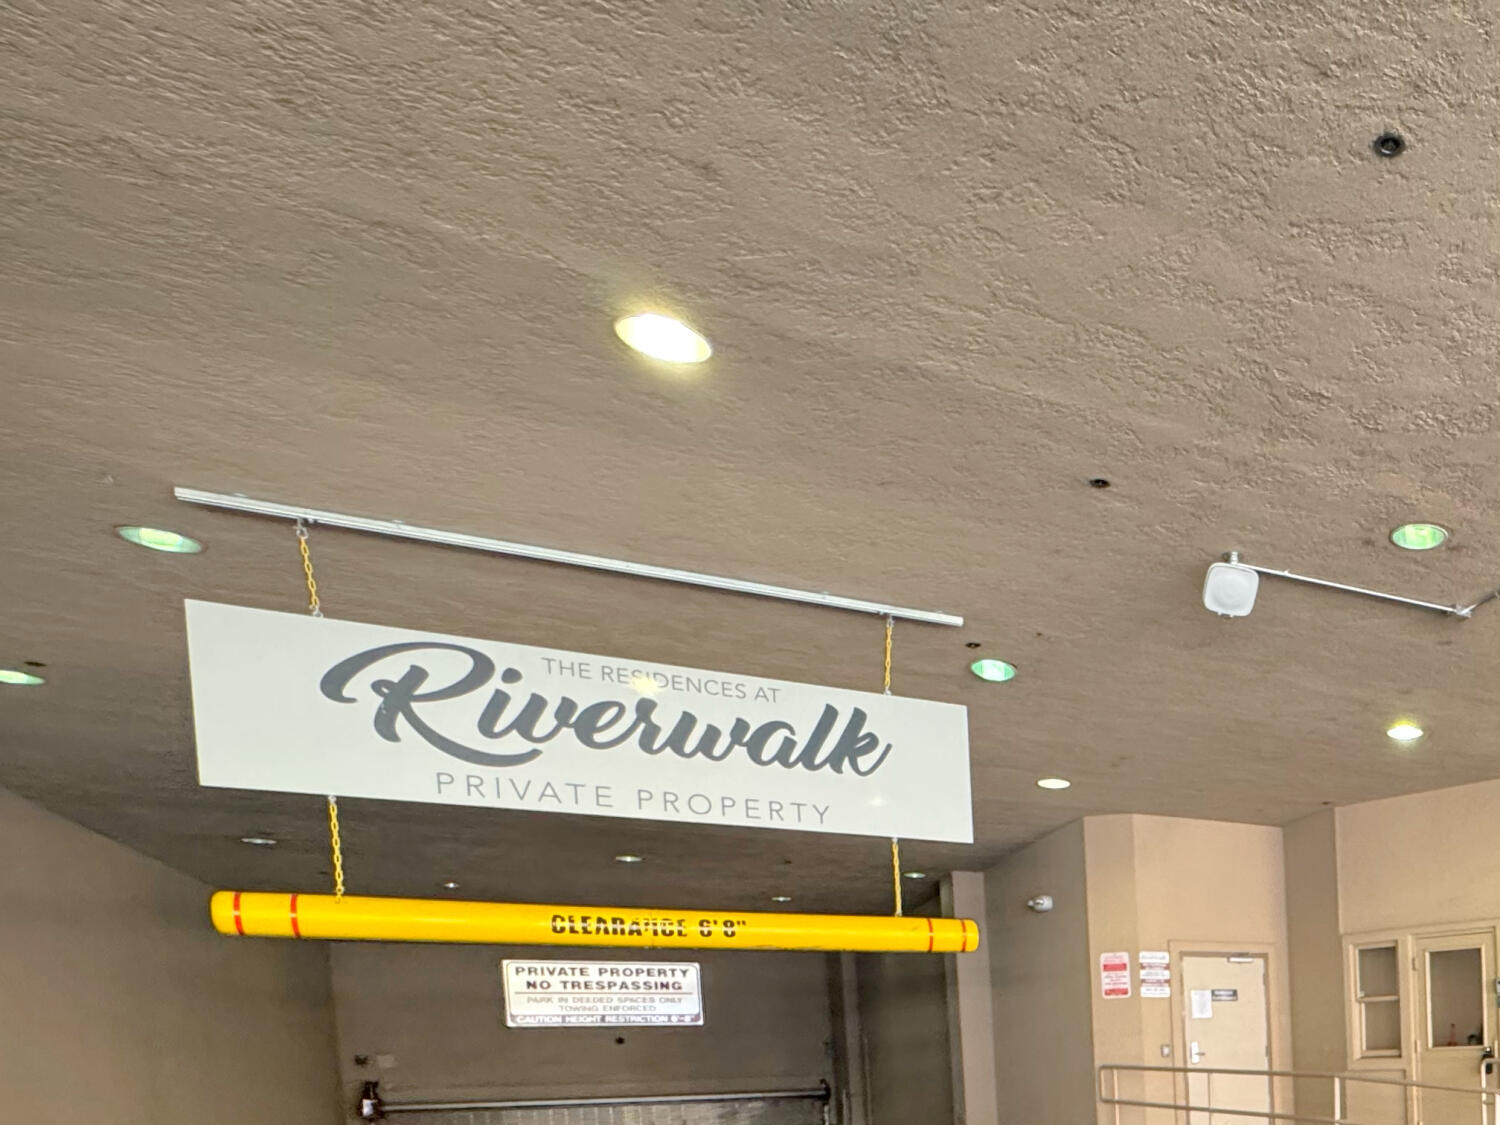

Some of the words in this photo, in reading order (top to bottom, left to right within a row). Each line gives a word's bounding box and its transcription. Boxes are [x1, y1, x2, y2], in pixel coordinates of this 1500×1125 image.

[541, 656, 593, 680] THE
[600, 664, 747, 699] RESIDENCES
[754, 685, 782, 704] AT
[319, 641, 893, 778] Riverwalk
[435, 771, 614, 808] PRIVATE
[636, 788, 831, 826] PROPERTY
[514, 966, 590, 977] PRIVATE
[598, 967, 690, 978] PROPERTY
[526, 980, 552, 990] NO
[560, 980, 684, 991] TRESPASSING
[527, 996, 553, 1004] PARK
[602, 1005, 657, 1013] ENFORCED
